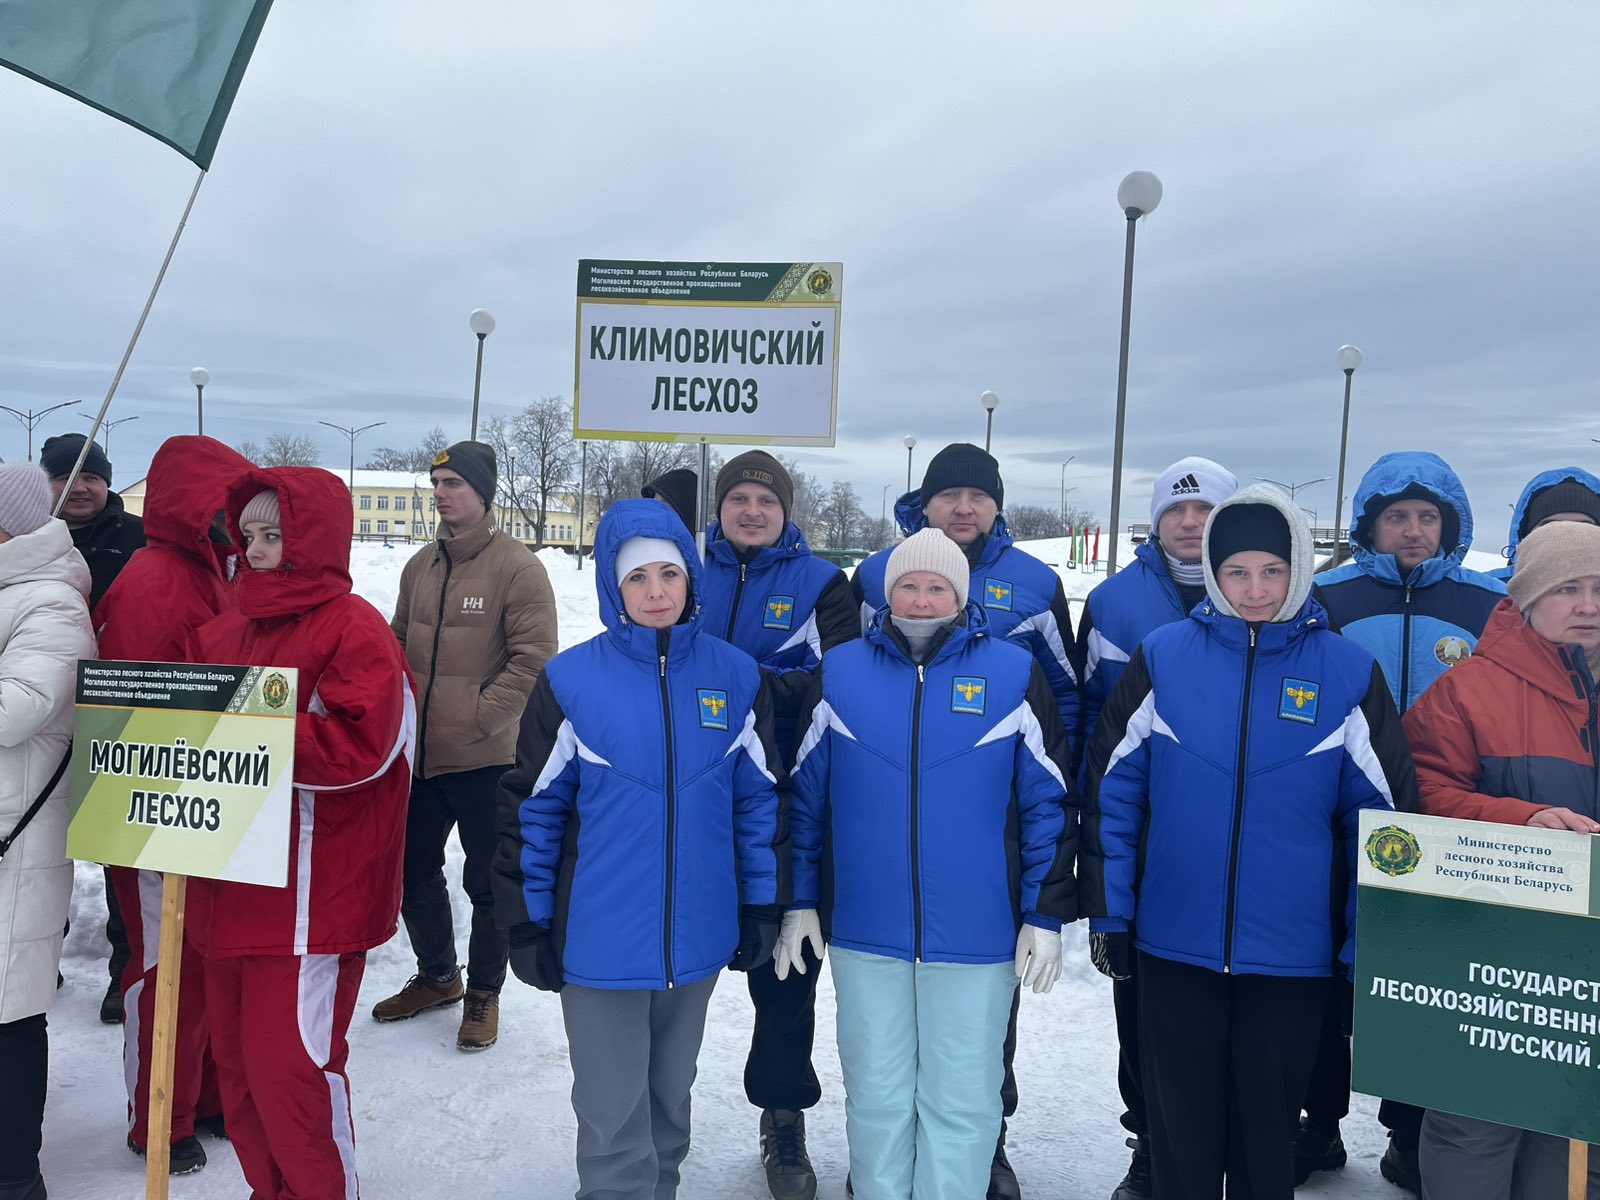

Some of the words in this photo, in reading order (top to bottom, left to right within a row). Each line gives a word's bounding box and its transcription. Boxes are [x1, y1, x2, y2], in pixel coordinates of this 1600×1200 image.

[590, 266, 634, 276] Министерство
[637, 269, 663, 277] лесного
[665, 269, 697, 277] хозяйства
[700, 269, 736, 278] Республики
[740, 270, 769, 279] Беларусь
[591, 277, 631, 285] Могилевское
[633, 279, 684, 288] государственное
[686, 280, 742, 288] производственное
[590, 285, 649, 294] лесохозяйственное
[651, 287, 691, 295] объединение
[590, 320, 825, 366] КЛИМОВИЧСКИЙ
[651, 376, 759, 414] ЛЕСХОЗ
[1171, 487, 1201, 496] adidas
[463, 597, 484, 609] HH
[83, 678, 118, 687] Могилевское
[118, 681, 165, 690] государственное
[165, 682, 218, 692] производственное
[84, 667, 122, 677] Министерство
[122, 670, 143, 678] лесного
[144, 670, 172, 679] хозяйства
[173, 670, 207, 681] Республики
[207, 671, 235, 682] Беларусь
[83, 688, 133, 699] лесохозяйственное
[134, 691, 171, 701] объединение
[90, 739, 270, 787] МОГИЛЁВСКИЙ
[127, 790, 221, 832] ЛЕСХОЗ
[1457, 835, 1552, 856] Министерство
[1444, 852, 1494, 866] лесного
[1497, 858, 1564, 875] хозяйства
[1435, 865, 1510, 885] Республики
[1514, 875, 1574, 893] Беларусь
[1468, 962, 1600, 1003] ГОСУДАРСТ
[1458, 1023, 1591, 1067] "ГЛУССКИЙ
